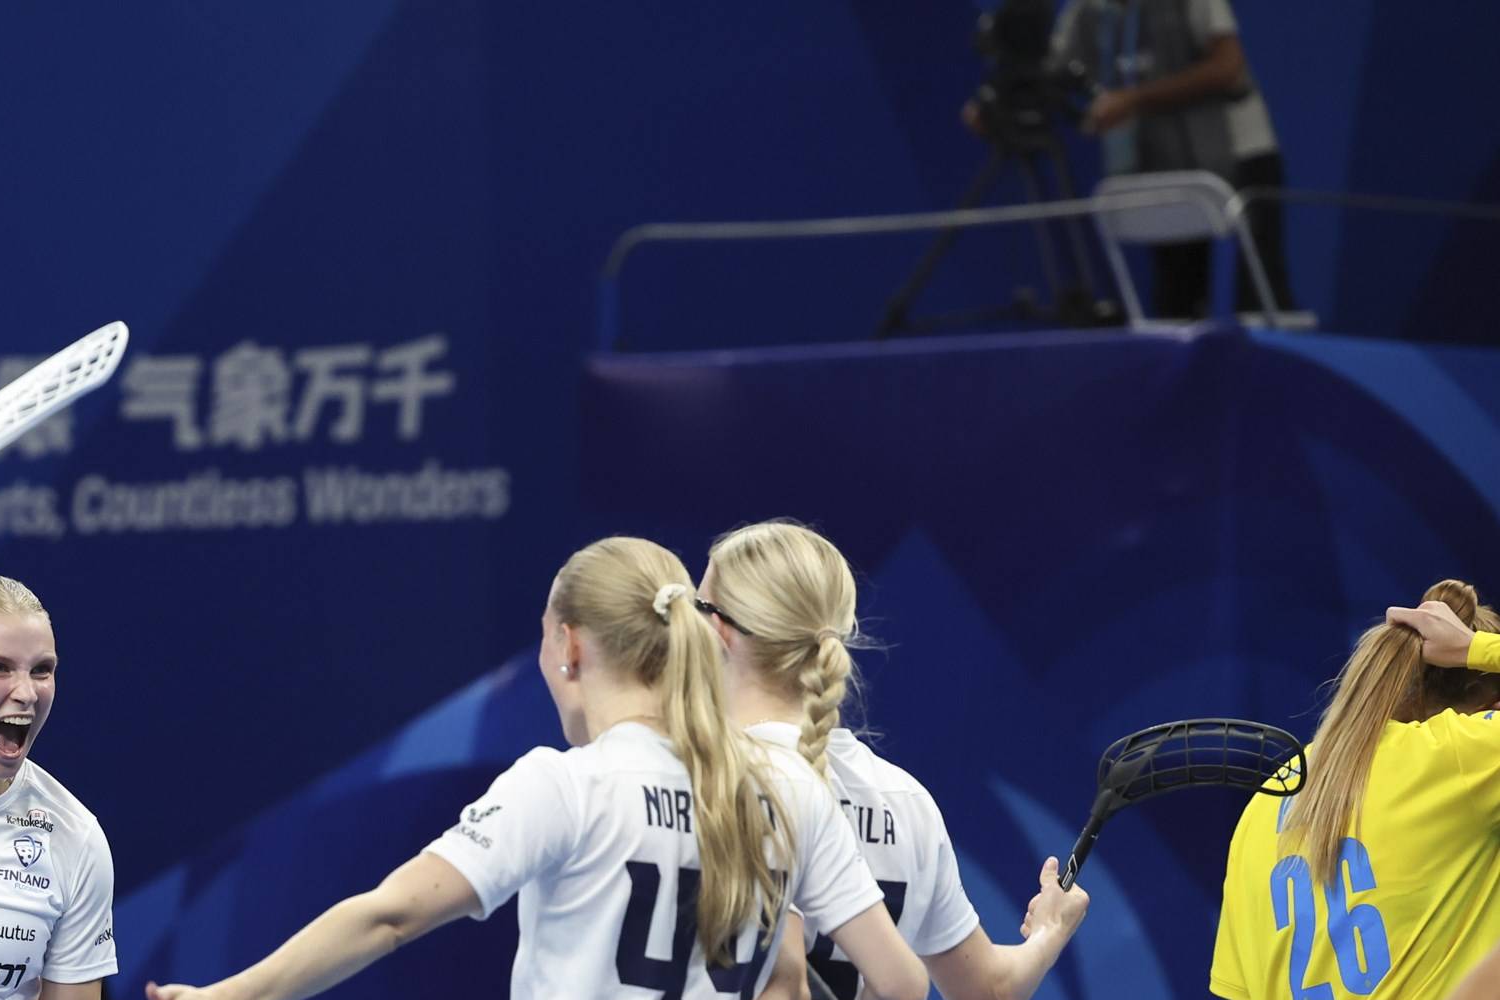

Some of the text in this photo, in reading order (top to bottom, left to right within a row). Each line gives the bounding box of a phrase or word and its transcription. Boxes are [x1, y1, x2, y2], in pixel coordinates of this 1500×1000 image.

[122, 338, 453, 447] 气象万千
[72, 468, 296, 534] Countless
[304, 465, 510, 520] Wonders
[6, 814, 54, 832] Kattokeskus
